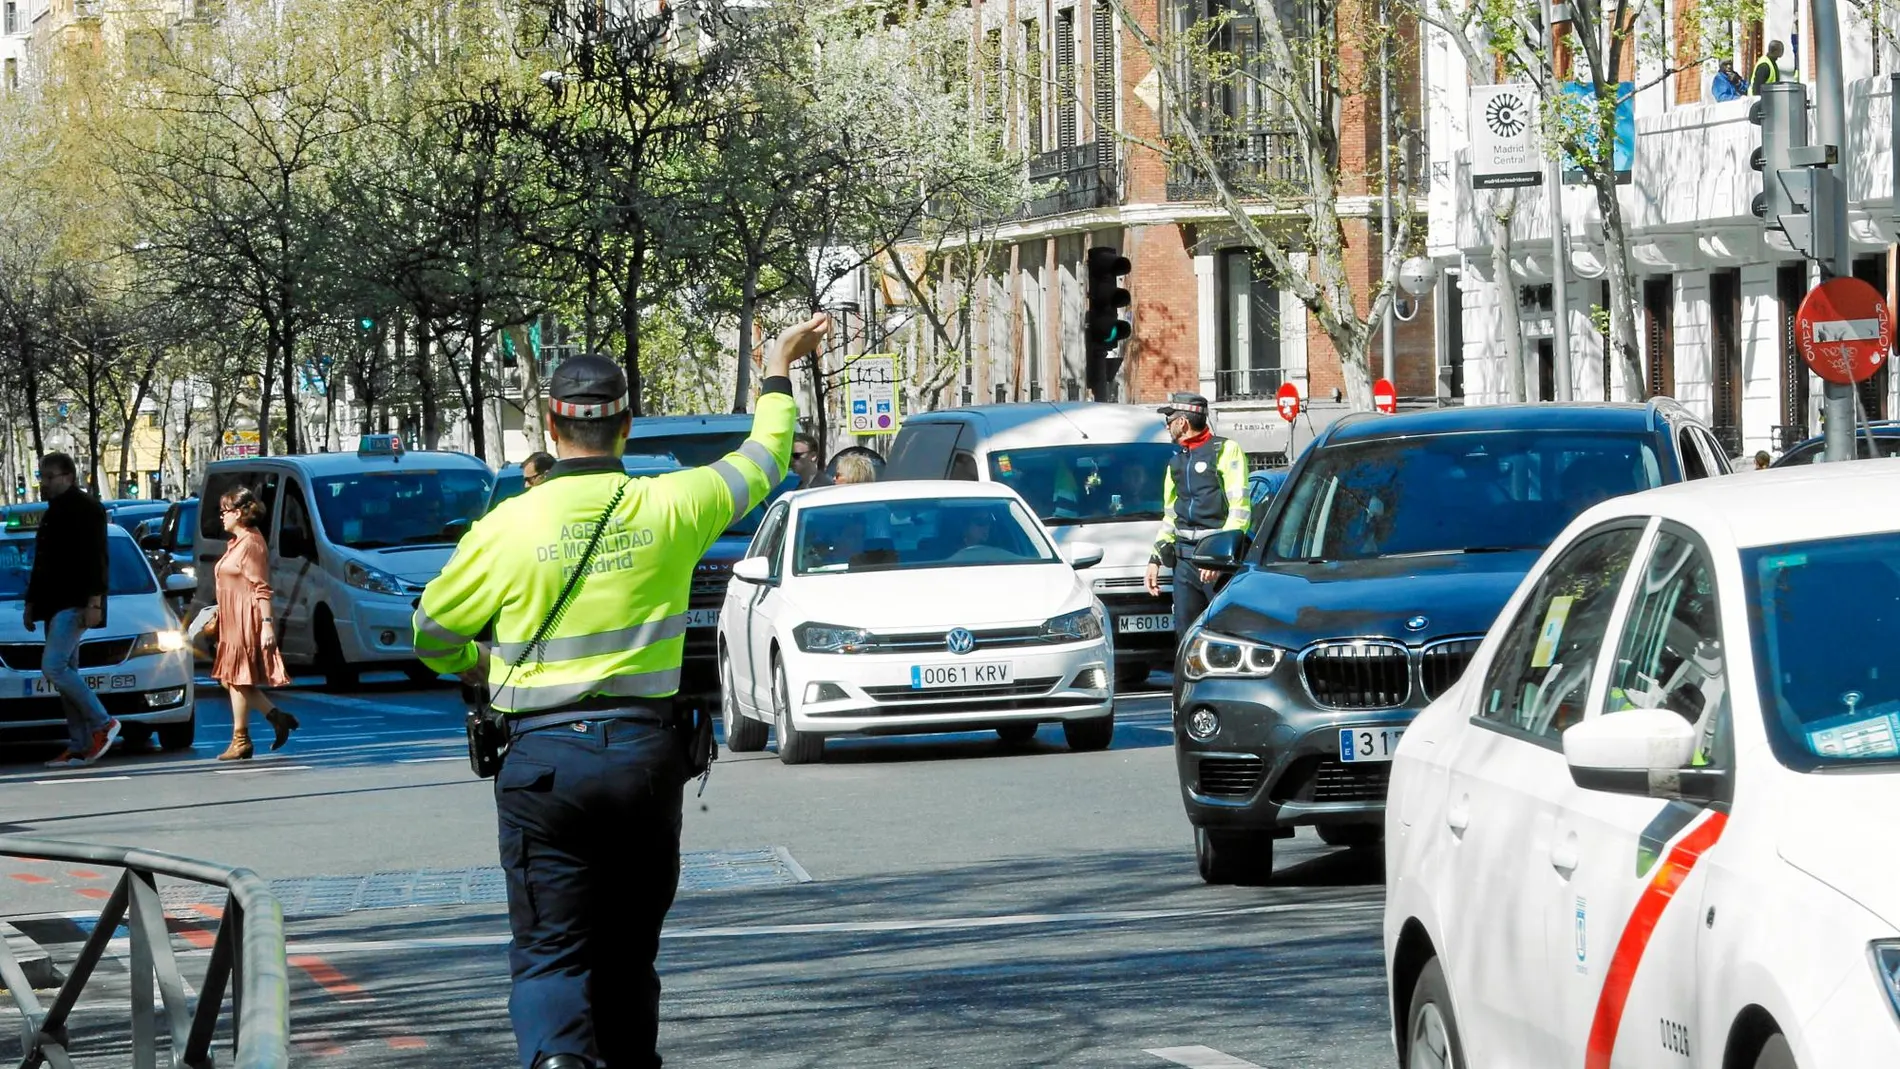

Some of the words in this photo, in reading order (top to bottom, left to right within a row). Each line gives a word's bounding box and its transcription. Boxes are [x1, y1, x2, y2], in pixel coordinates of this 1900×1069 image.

[1493, 144, 1525, 153] Madrid
[1493, 156, 1526, 165] Central
[391, 437, 400, 450] 2
[561, 518, 628, 541] AGETE
[536, 544, 560, 562] DE
[563, 528, 654, 559] MOILIDAD
[1120, 615, 1170, 631] M-6018
[924, 666, 967, 684] 0061
[975, 664, 1007, 682] KRV
[1344, 748, 1351, 756] E
